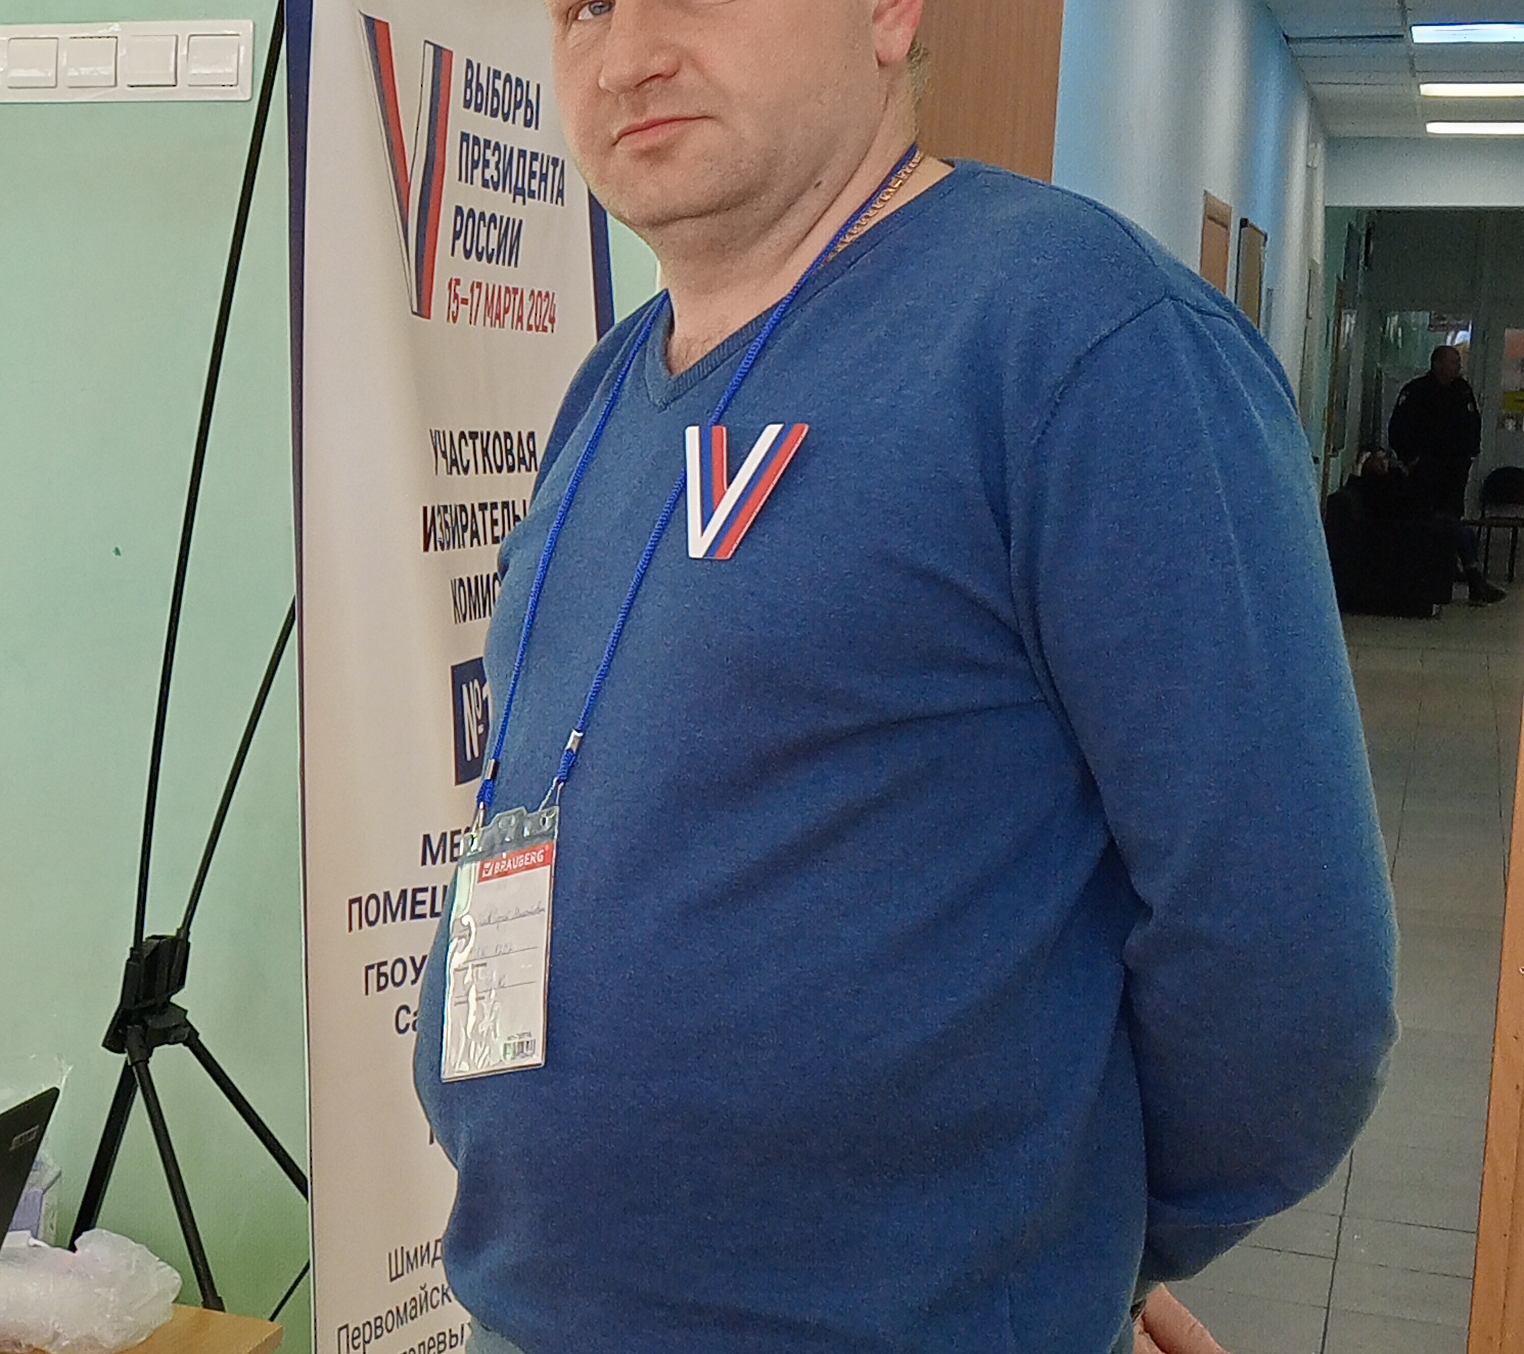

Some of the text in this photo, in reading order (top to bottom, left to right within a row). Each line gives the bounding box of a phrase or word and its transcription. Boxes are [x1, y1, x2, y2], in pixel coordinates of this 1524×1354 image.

[462, 57, 541, 131] ВЫБОРЫ
[458, 130, 566, 208] ПРЕЗИДЕНТА
[450, 205, 524, 268] РОССИИ
[483, 282, 525, 333] МАРТА
[526, 289, 557, 335] 2024
[429, 428, 539, 476] УЧАСТКОВАЯ
[494, 848, 545, 876] BRAUBERG
[364, 954, 428, 995] ГБОУ
